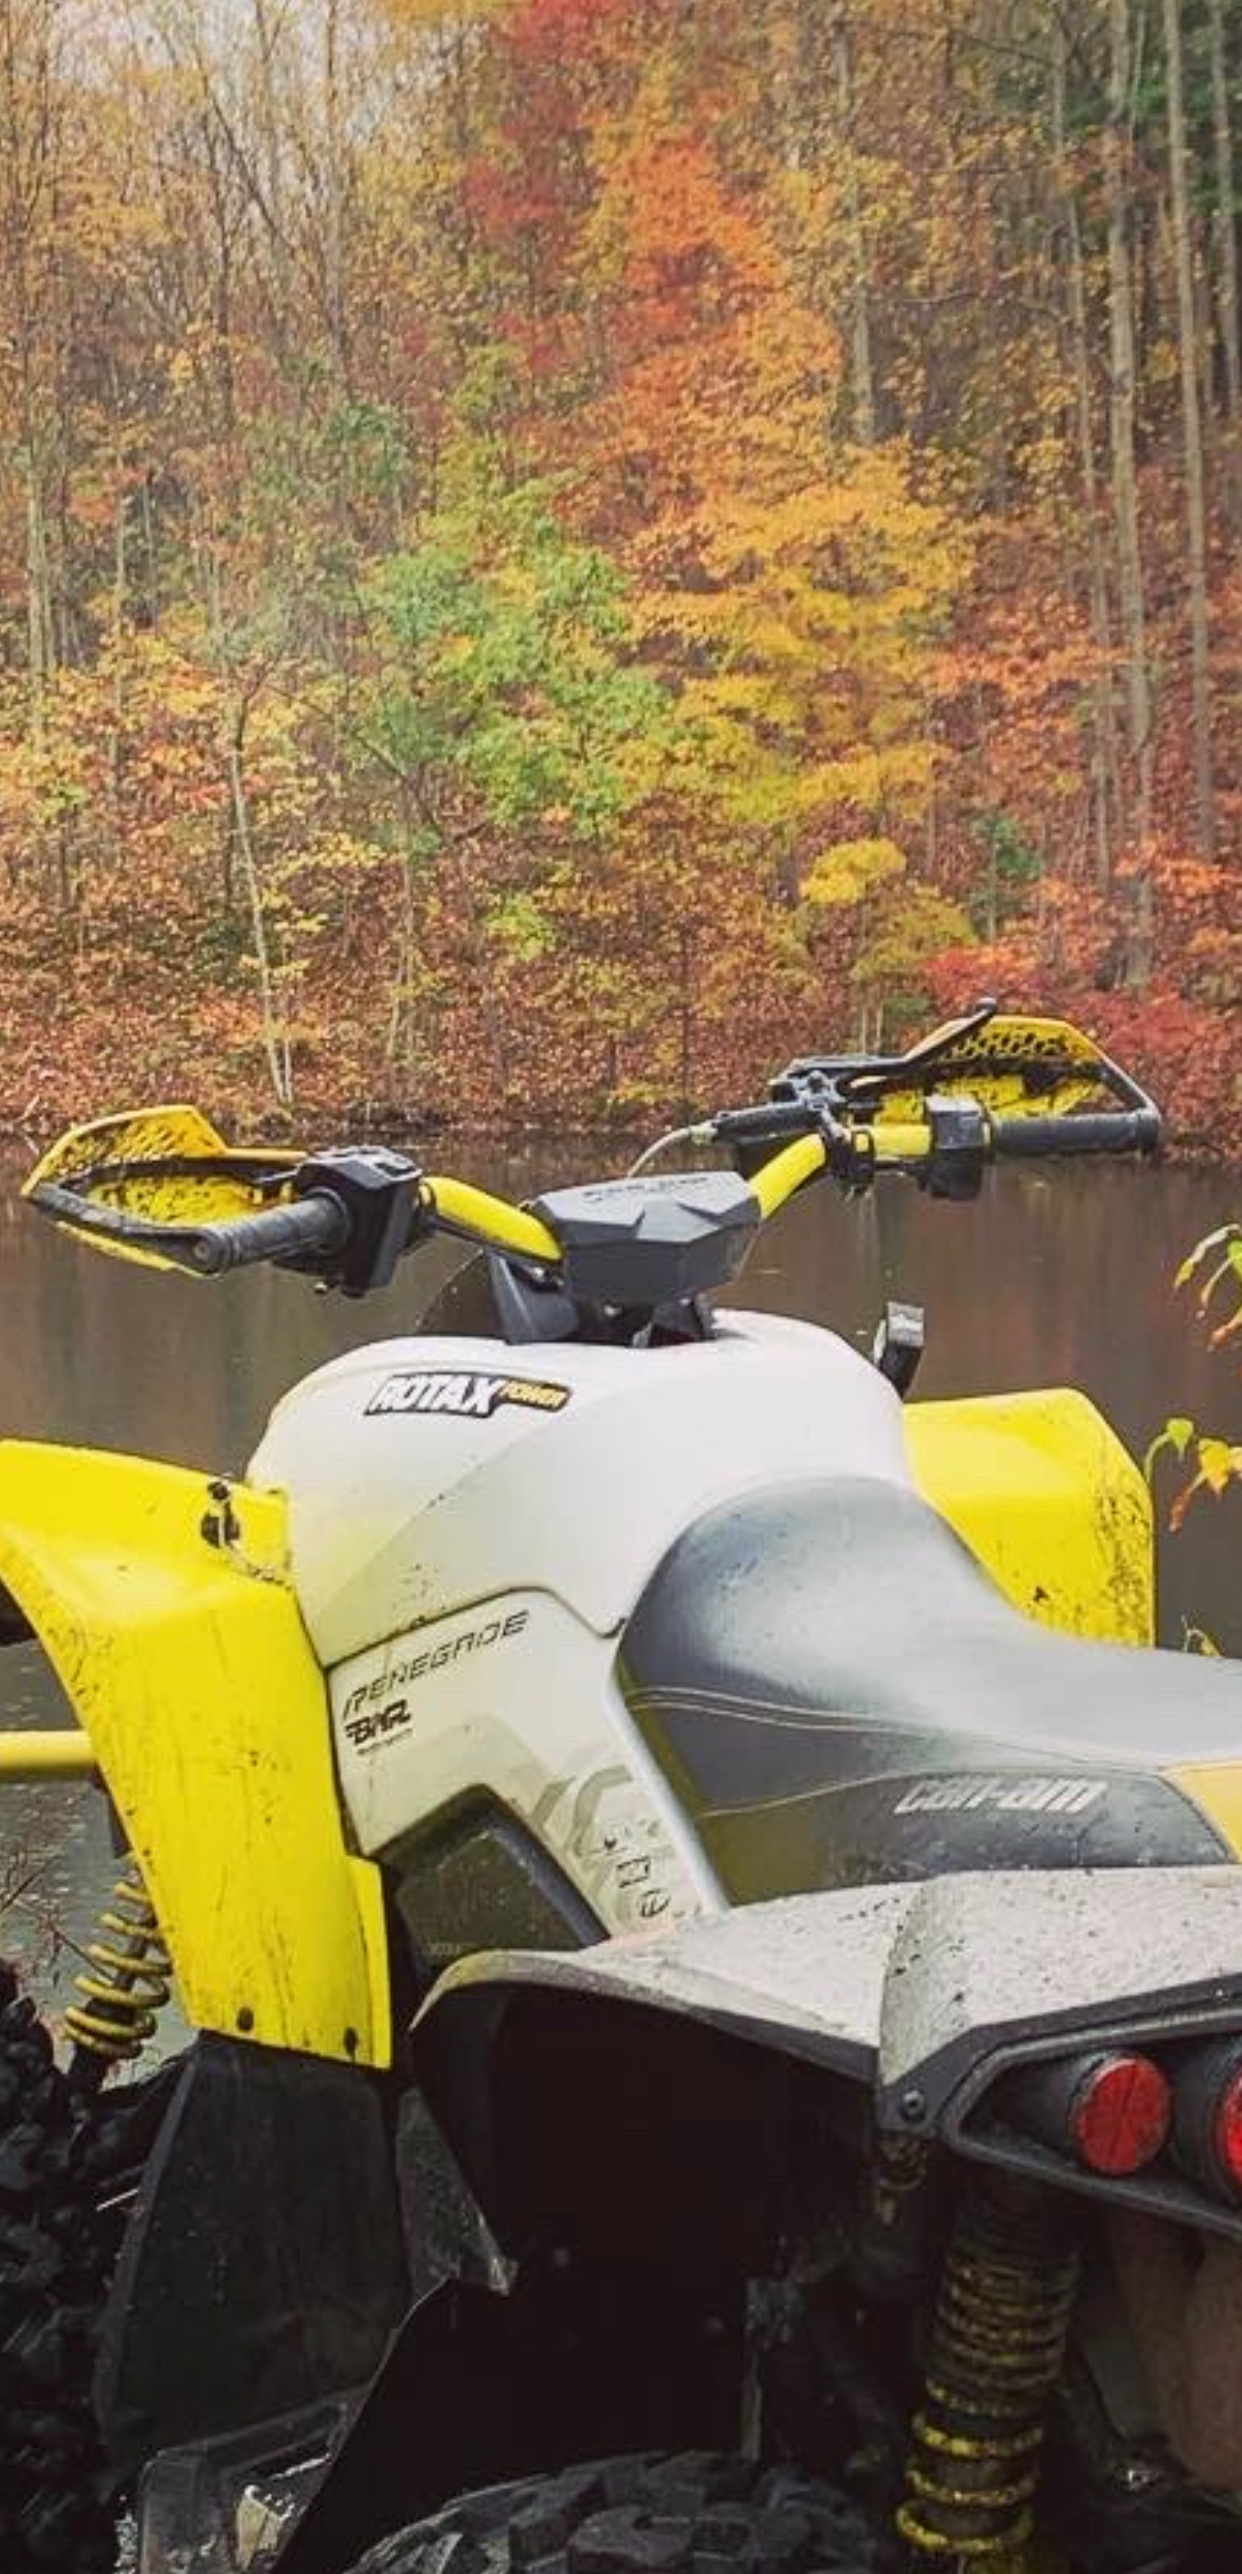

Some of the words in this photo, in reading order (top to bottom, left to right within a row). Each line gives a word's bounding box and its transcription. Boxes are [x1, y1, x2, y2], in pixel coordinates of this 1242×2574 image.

[367, 1373, 501, 1416] ROTAX
[500, 1379, 570, 1408] POWER
[343, 1610, 529, 1719] RENEGADE
